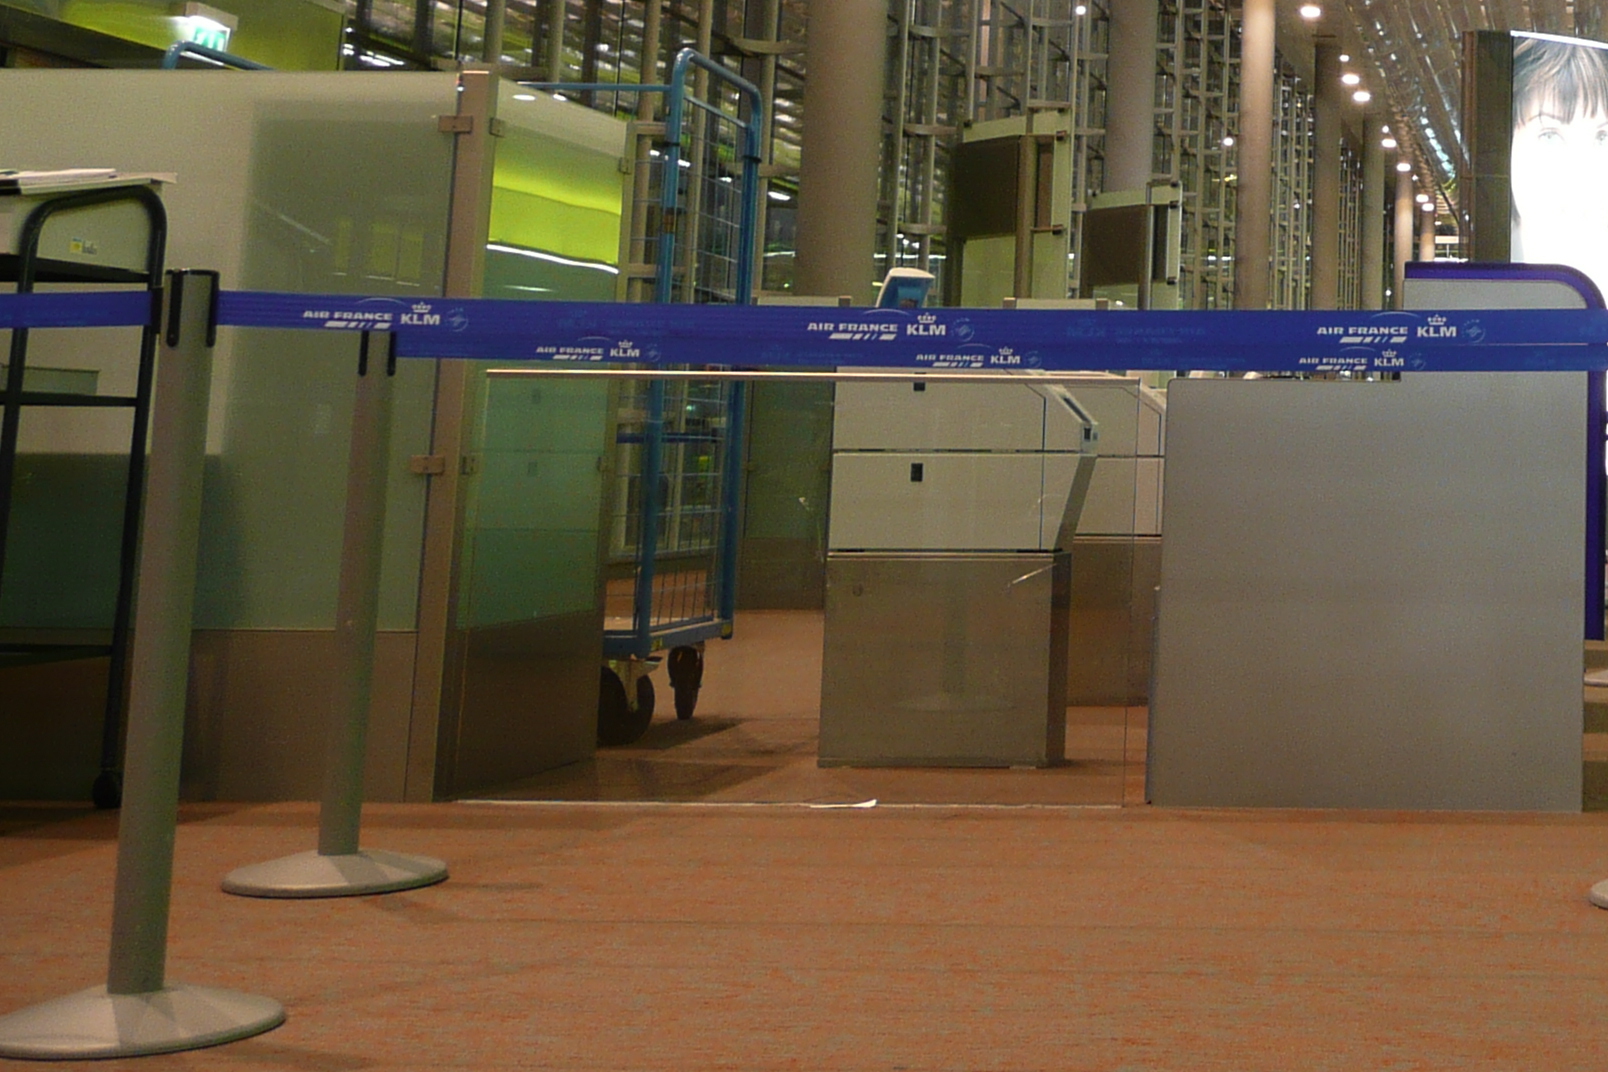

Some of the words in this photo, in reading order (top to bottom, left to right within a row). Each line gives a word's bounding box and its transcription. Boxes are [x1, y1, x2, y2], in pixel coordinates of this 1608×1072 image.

[302, 309, 330, 320] AIR
[333, 311, 393, 322] FRANCE
[400, 312, 441, 326] KLM
[807, 322, 834, 331] AIR
[838, 322, 899, 333] FRANCE
[906, 323, 947, 337] KLM
[1316, 326, 1344, 335] AIR
[1347, 326, 1409, 336] FRANCE
[1416, 325, 1458, 339] KLM
[535, 345, 557, 354] AIR
[559, 346, 604, 354] FRANCE
[609, 347, 640, 358] KLM
[939, 354, 984, 362] FRANCE
[990, 354, 1021, 365] KLM
[1298, 357, 1320, 365] AIR
[1322, 357, 1368, 365] FRANCE
[1373, 356, 1405, 367] KLM
